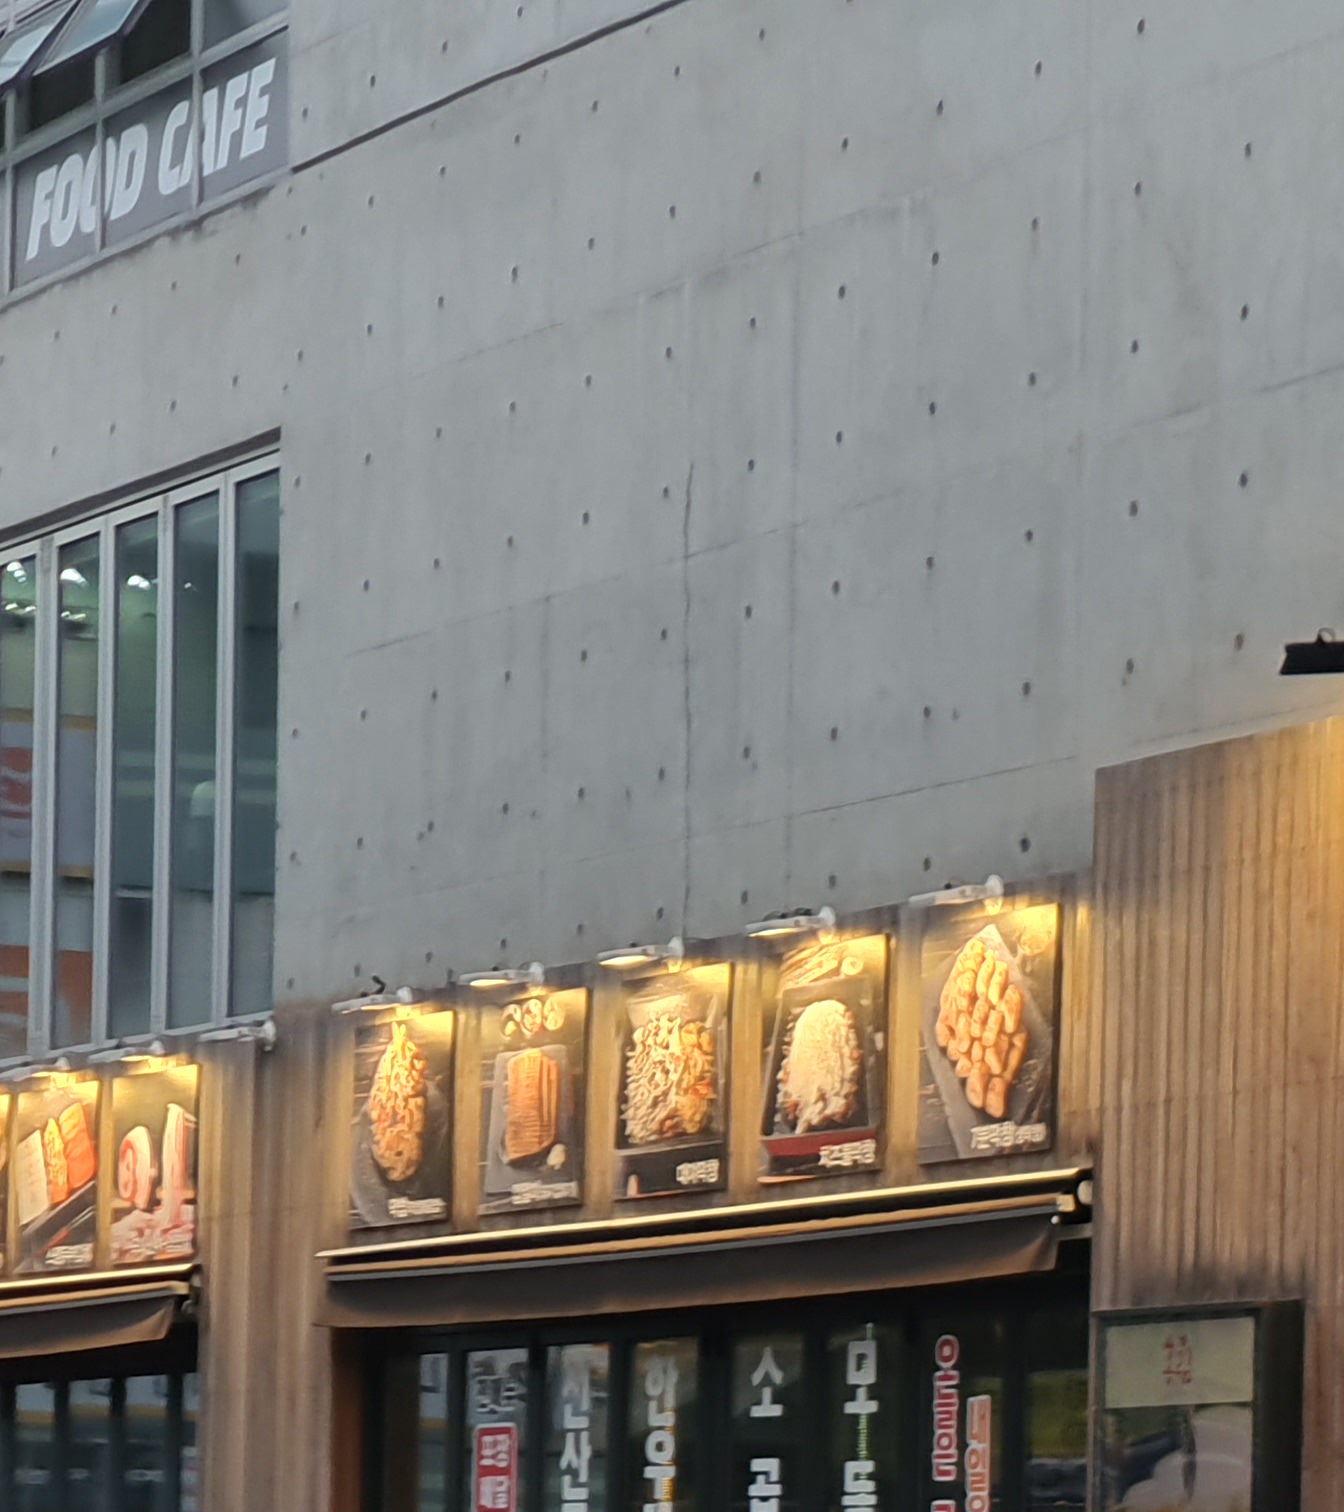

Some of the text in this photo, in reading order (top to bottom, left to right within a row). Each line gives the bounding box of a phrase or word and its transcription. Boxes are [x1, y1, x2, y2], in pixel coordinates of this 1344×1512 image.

[25, 57, 276, 261] FOOD CAFE
[932, 1333, 960, 1482] 오늘은
